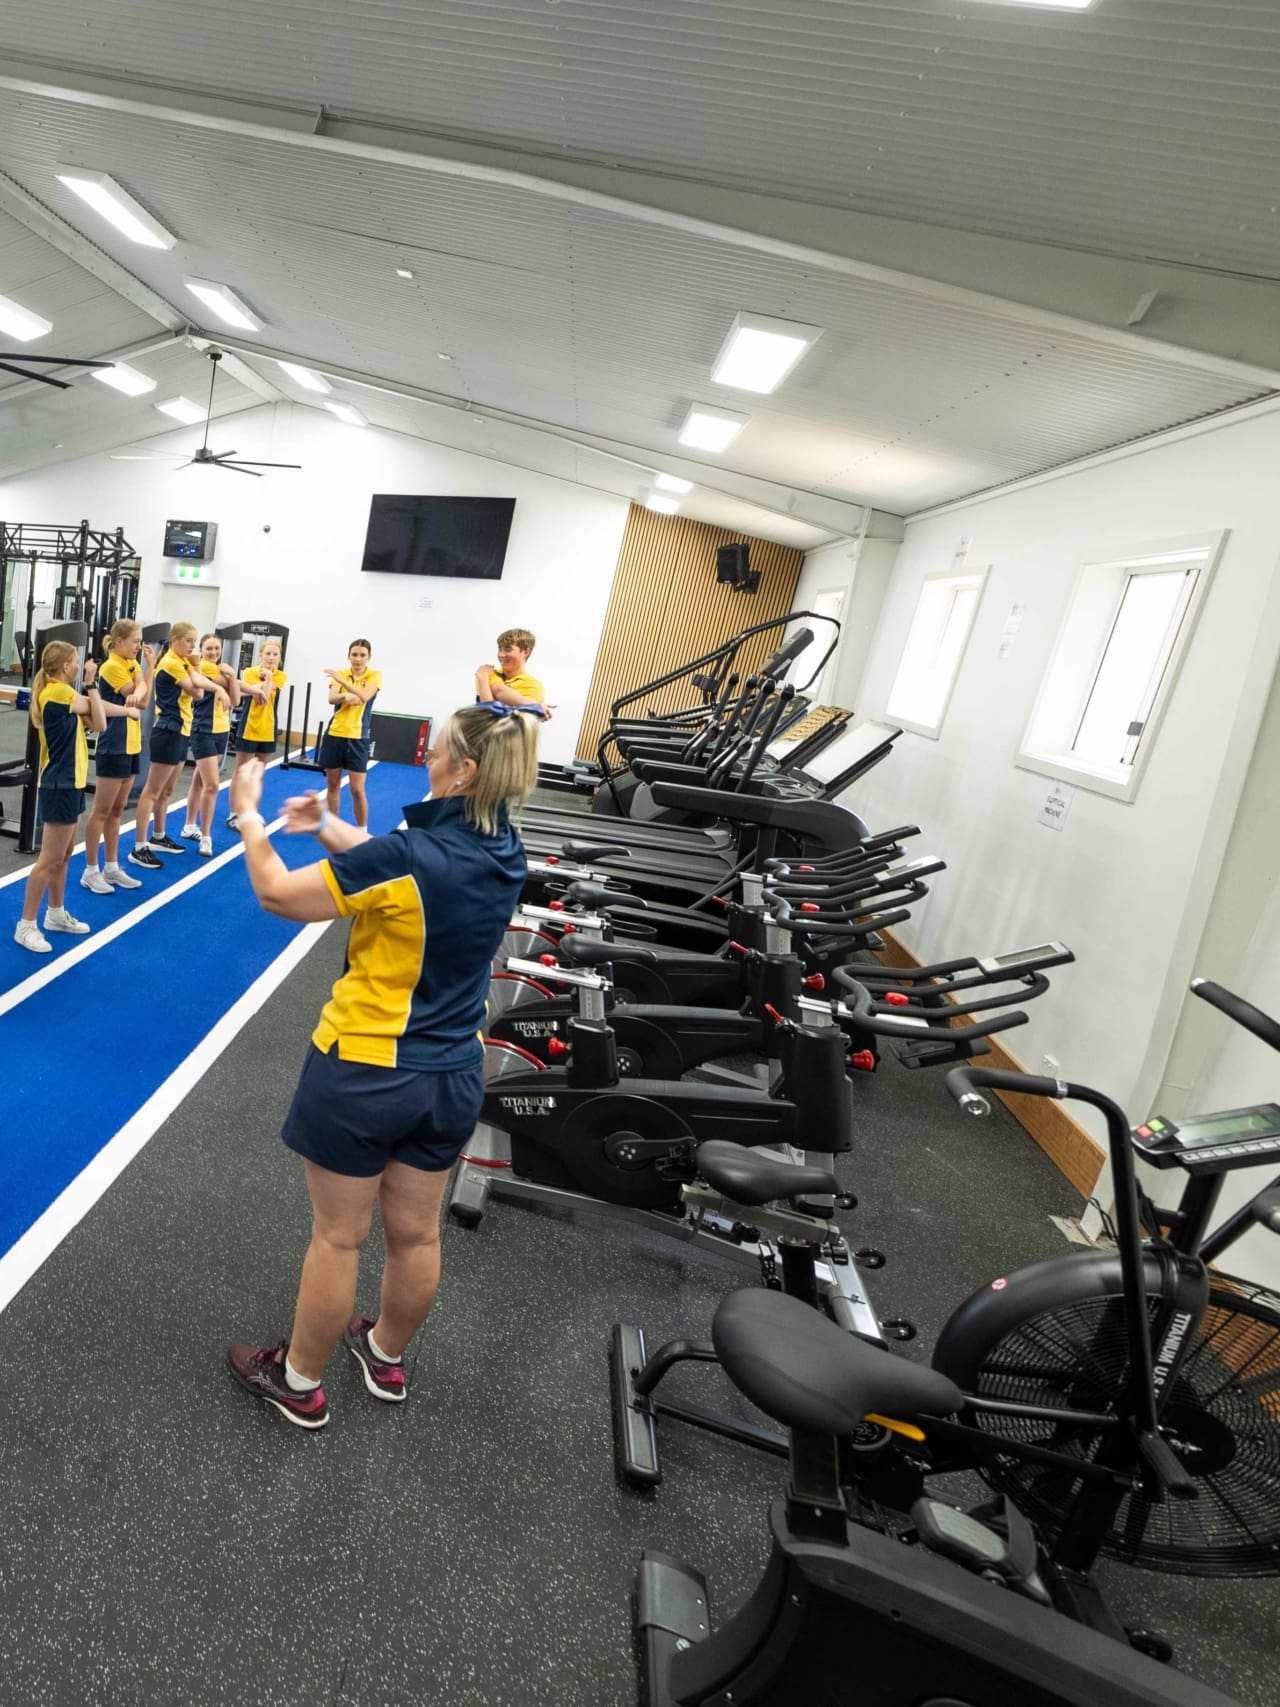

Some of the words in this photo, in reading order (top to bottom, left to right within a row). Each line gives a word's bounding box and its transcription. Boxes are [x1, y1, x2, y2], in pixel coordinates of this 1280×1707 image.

[512, 1021, 559, 1031] TITANIUM
[500, 1096, 557, 1108] TITANIUM
[1158, 1313, 1191, 1364] TITANIUM
